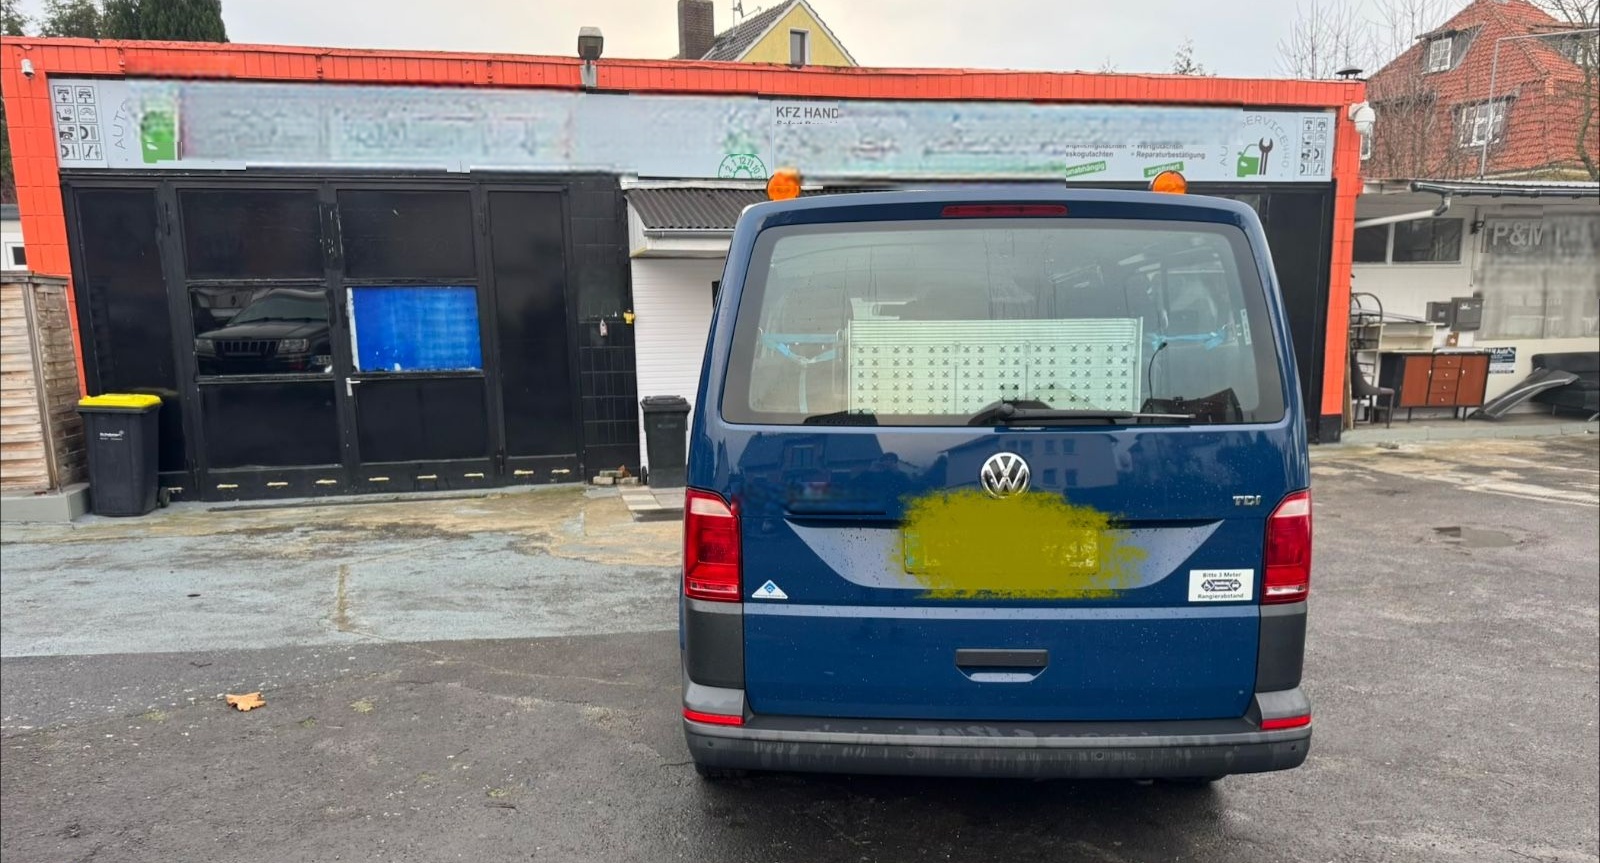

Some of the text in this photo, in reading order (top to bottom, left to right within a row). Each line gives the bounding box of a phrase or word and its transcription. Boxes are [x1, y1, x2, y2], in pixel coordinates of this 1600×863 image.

[776, 106, 839, 119] KFZ HAND
[1136, 151, 1206, 160] Reparaturbestätigung
[1233, 495, 1261, 506] TDI
